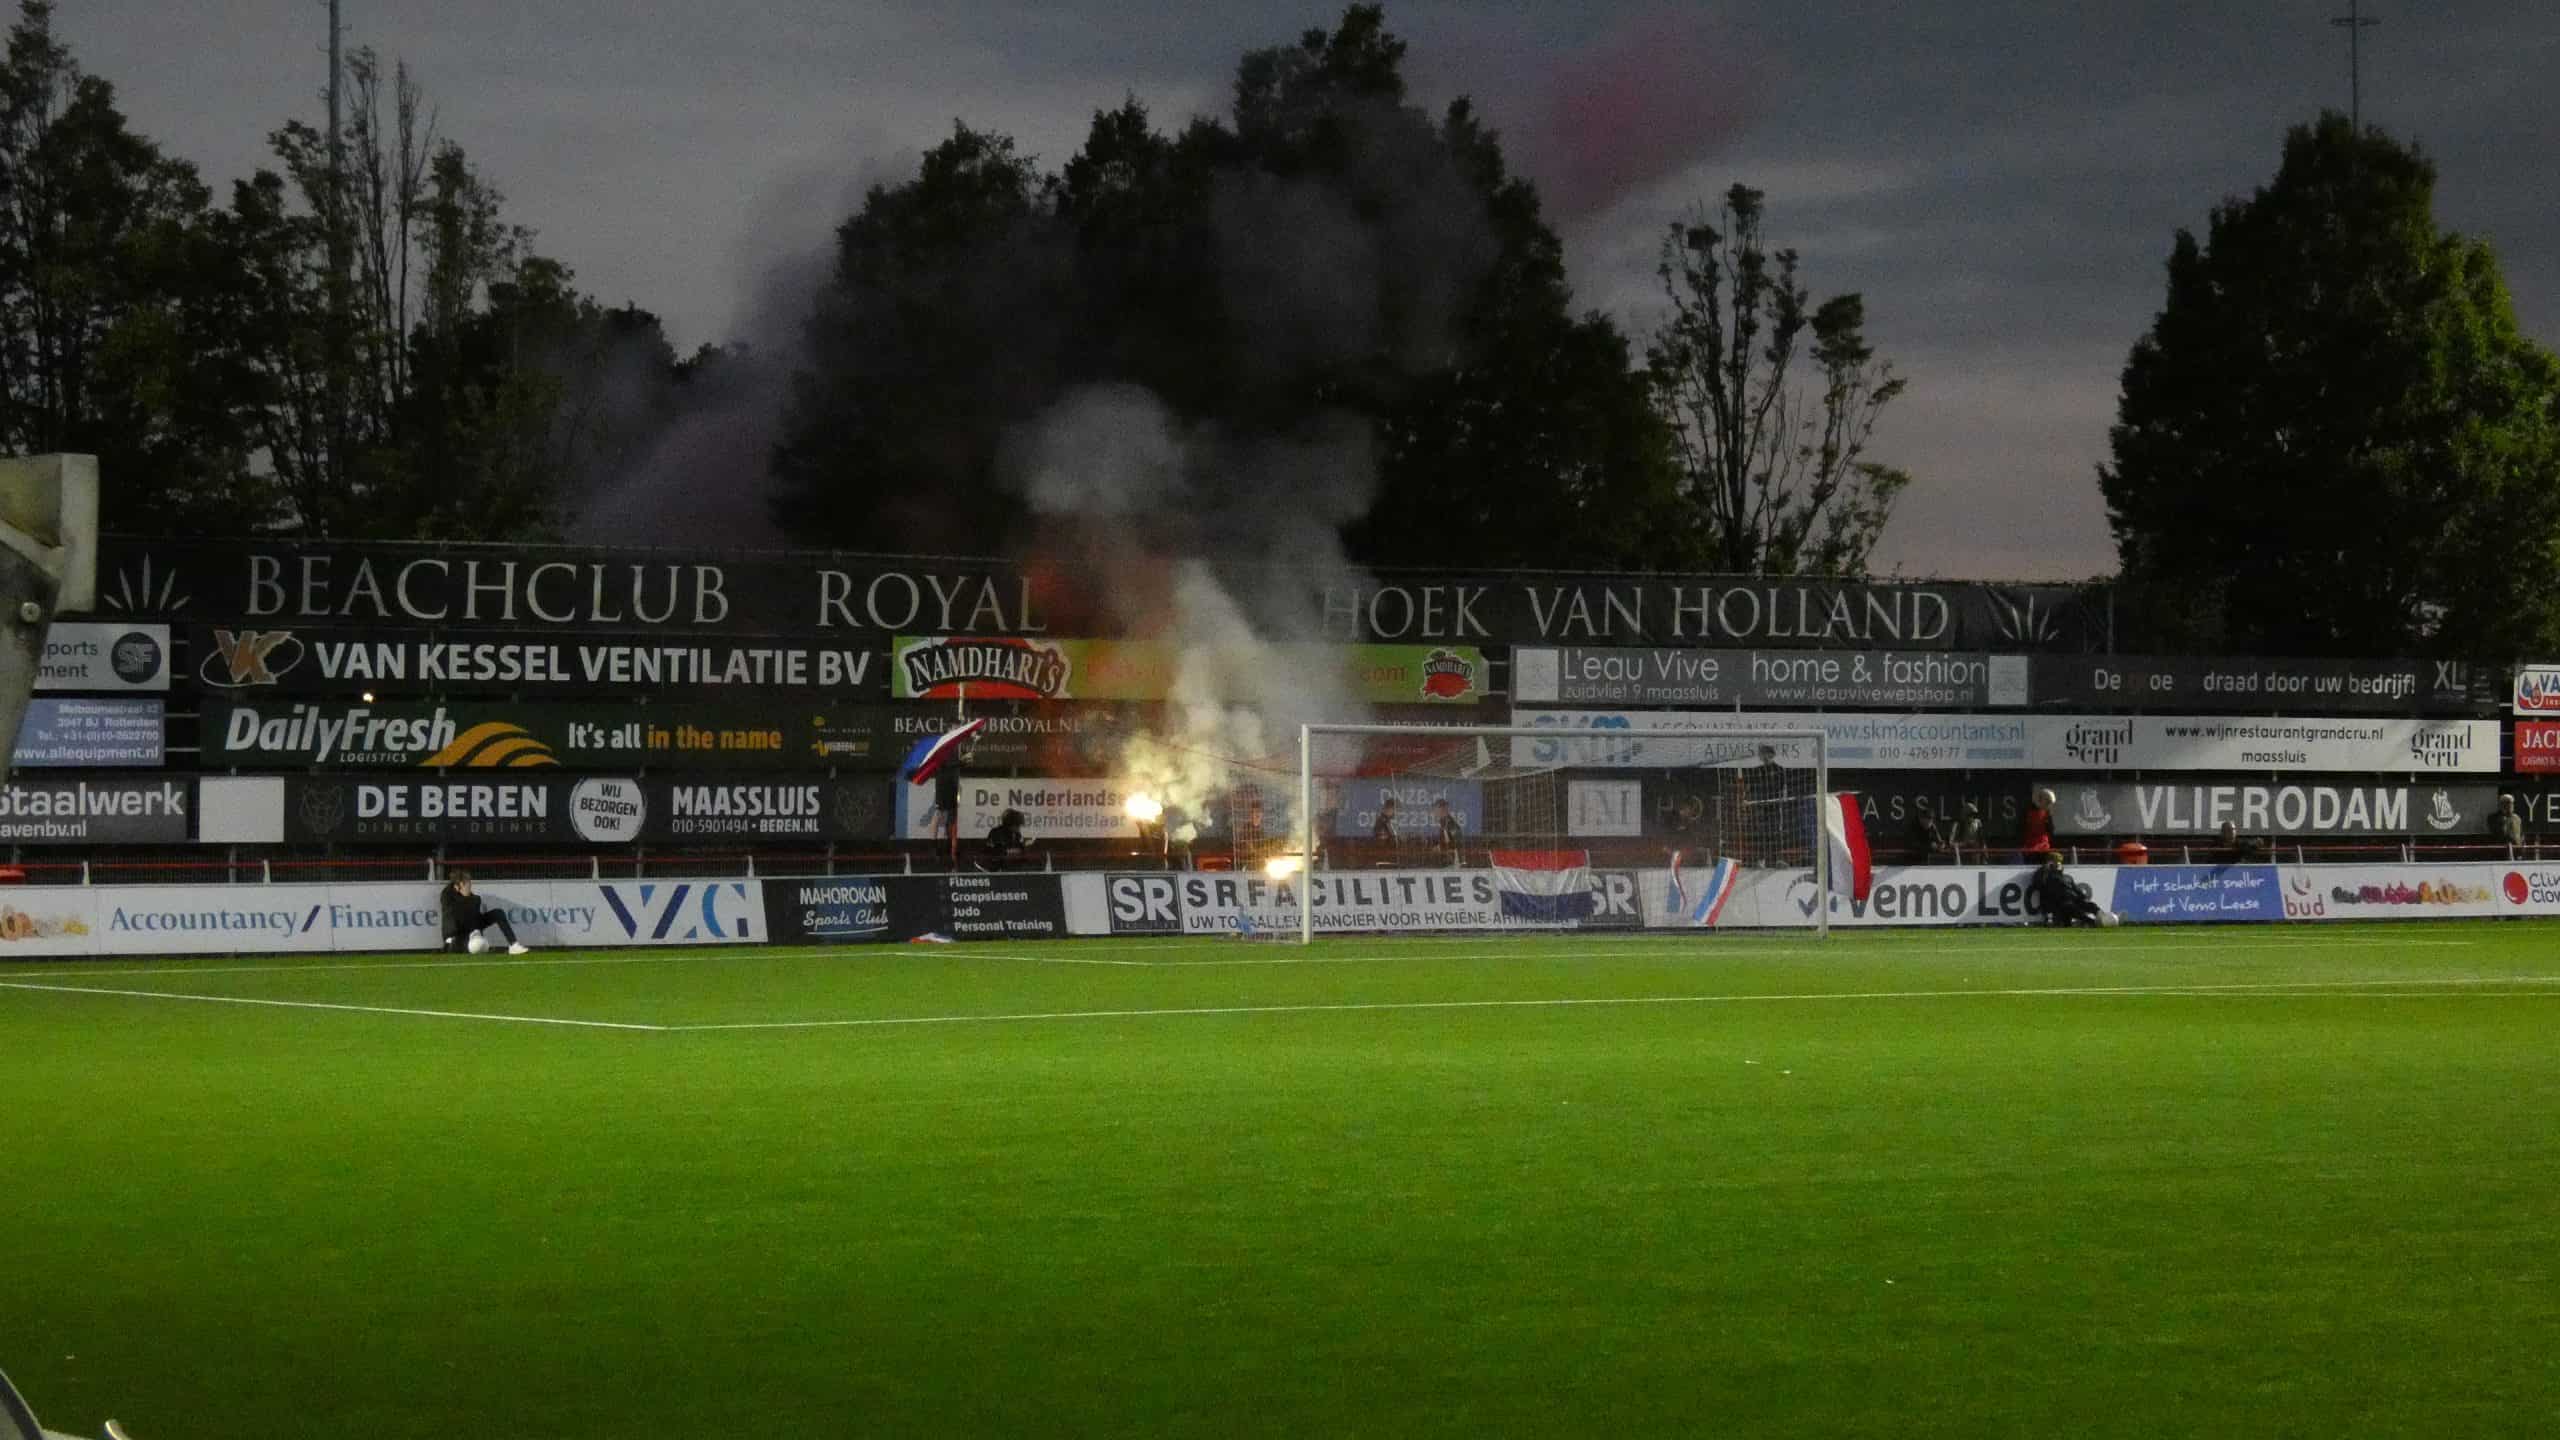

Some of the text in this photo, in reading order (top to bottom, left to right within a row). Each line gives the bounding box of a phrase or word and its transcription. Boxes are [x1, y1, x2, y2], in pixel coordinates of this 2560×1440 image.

[245, 555, 1949, 640] BEACHCLUB ROYAL HOEK VAN HOLLAND
[46, 641, 99, 659] ports
[38, 663, 89, 679] ment
[315, 642, 870, 686] VAN KESSEL VENTILATIE BV
[911, 646, 1060, 694] NAMDHARI'S
[1564, 649, 1986, 685] L'eau Vive home & fashion
[1647, 684, 1720, 700] maassluis
[2094, 668, 2121, 691] De
[2203, 671, 2258, 692] draad
[2265, 671, 2309, 693] door
[2315, 676, 2342, 693] uw
[2350, 673, 2416, 700] bedrijf!
[2540, 673, 2560, 693] VA
[225, 703, 457, 763] DailyFresh
[568, 722, 605, 749] It's
[611, 722, 642, 749] all
[648, 723, 670, 749] in
[676, 724, 714, 750] the
[720, 729, 782, 750] name
[1814, 720, 2025, 740] ww.skmaccountants.nl
[2066, 719, 2134, 758] grand
[2165, 724, 2384, 743] www.wijnrestaurantgrandcru.nl
[1705, 743, 1800, 760] ADVISRS
[2411, 725, 2472, 760] grand
[339, 752, 408, 763] LOGISTICS
[2079, 745, 2119, 765] cru
[2241, 749, 2307, 764] maassluis
[2423, 750, 2459, 768] cru
[601, 783, 622, 799] WIJ
[672, 786, 820, 816] MAASSLUIS
[975, 789, 1000, 807] De
[357, 784, 548, 819] DE BEREN
[580, 797, 639, 817] BEZORGEN
[2135, 785, 2408, 830] VLIERODAM
[357, 822, 548, 833] DINNER DRINKS
[593, 815, 621, 831] OOK!
[759, 818, 820, 833] BEREN.NL
[975, 813, 1003, 829] Zo
[949, 877, 990, 888] Fitness
[2133, 871, 2265, 893] Het schakelt sneller
[800, 886, 887, 905] MAHOROKAN
[951, 890, 1028, 903] Groepslessen
[1112, 878, 1177, 922] SR
[2148, 900, 2175, 914] met
[2221, 893, 2260, 911] Lease
[2285, 893, 2325, 917] bud
[109, 906, 297, 938] Accountancy
[329, 903, 438, 929] Finance
[482, 904, 596, 933] covery
[803, 909, 889, 931] Sports Club
[952, 905, 980, 918] Judo
[1190, 915, 1214, 929] UW
[1380, 910, 1421, 927] VOOR
[954, 919, 1053, 933] Personal Training
